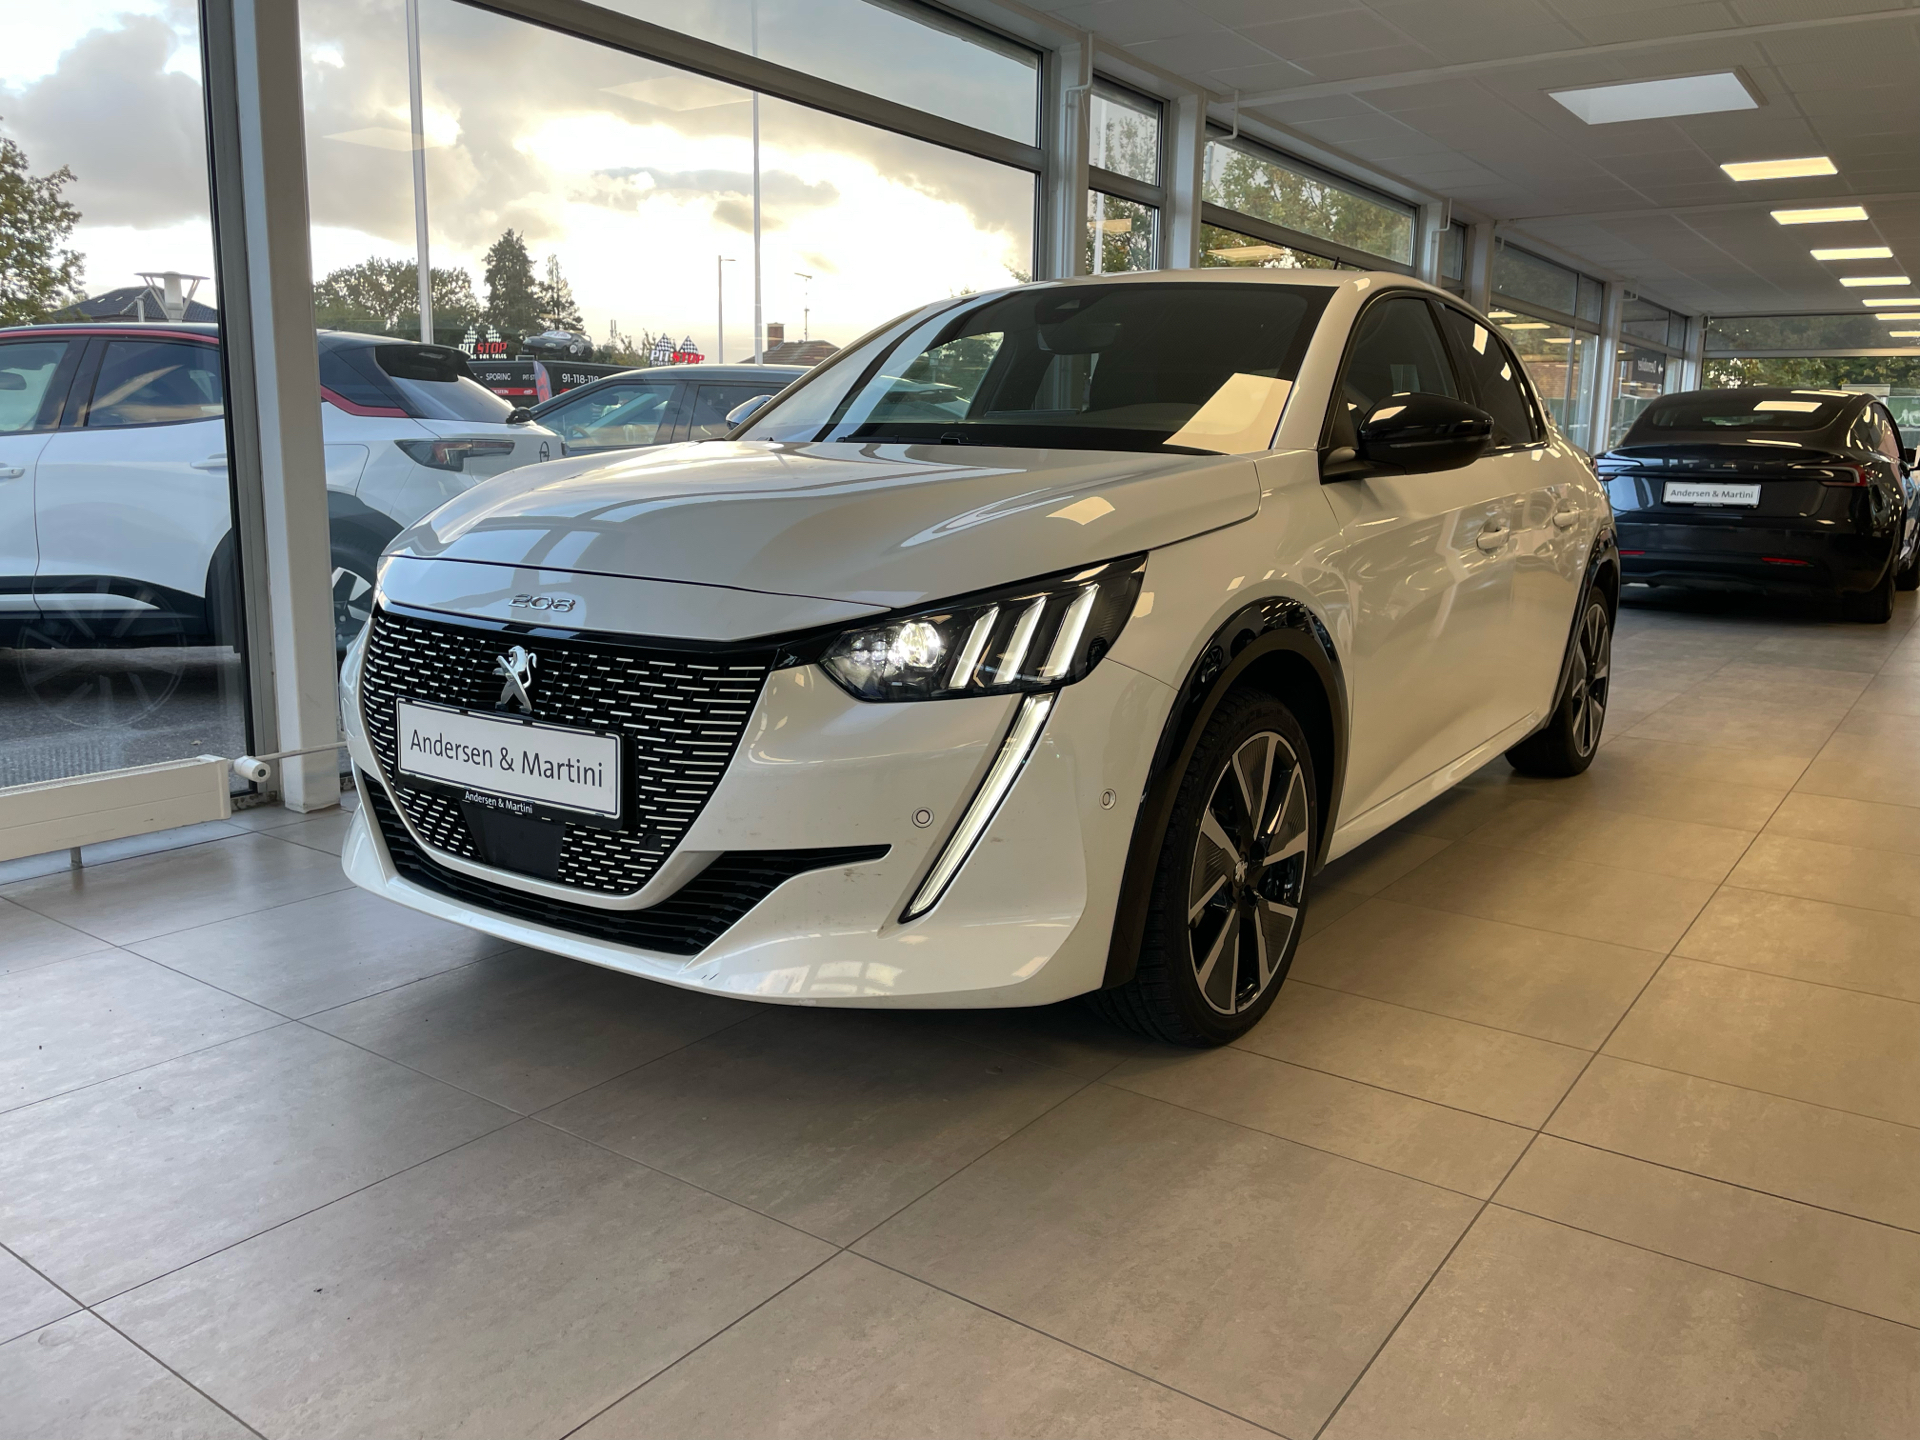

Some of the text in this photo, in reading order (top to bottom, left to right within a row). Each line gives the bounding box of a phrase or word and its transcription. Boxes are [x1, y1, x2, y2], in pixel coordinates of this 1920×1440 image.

[477, 341, 507, 354] STOP
[650, 349, 705, 364] PIT STOP
[1670, 489, 1710, 497] Andersen
[1721, 490, 1753, 498] Martini
[508, 593, 576, 613] 208
[410, 729, 603, 788] Andersen & Martini
[465, 790, 533, 814] Andersen & Martini
